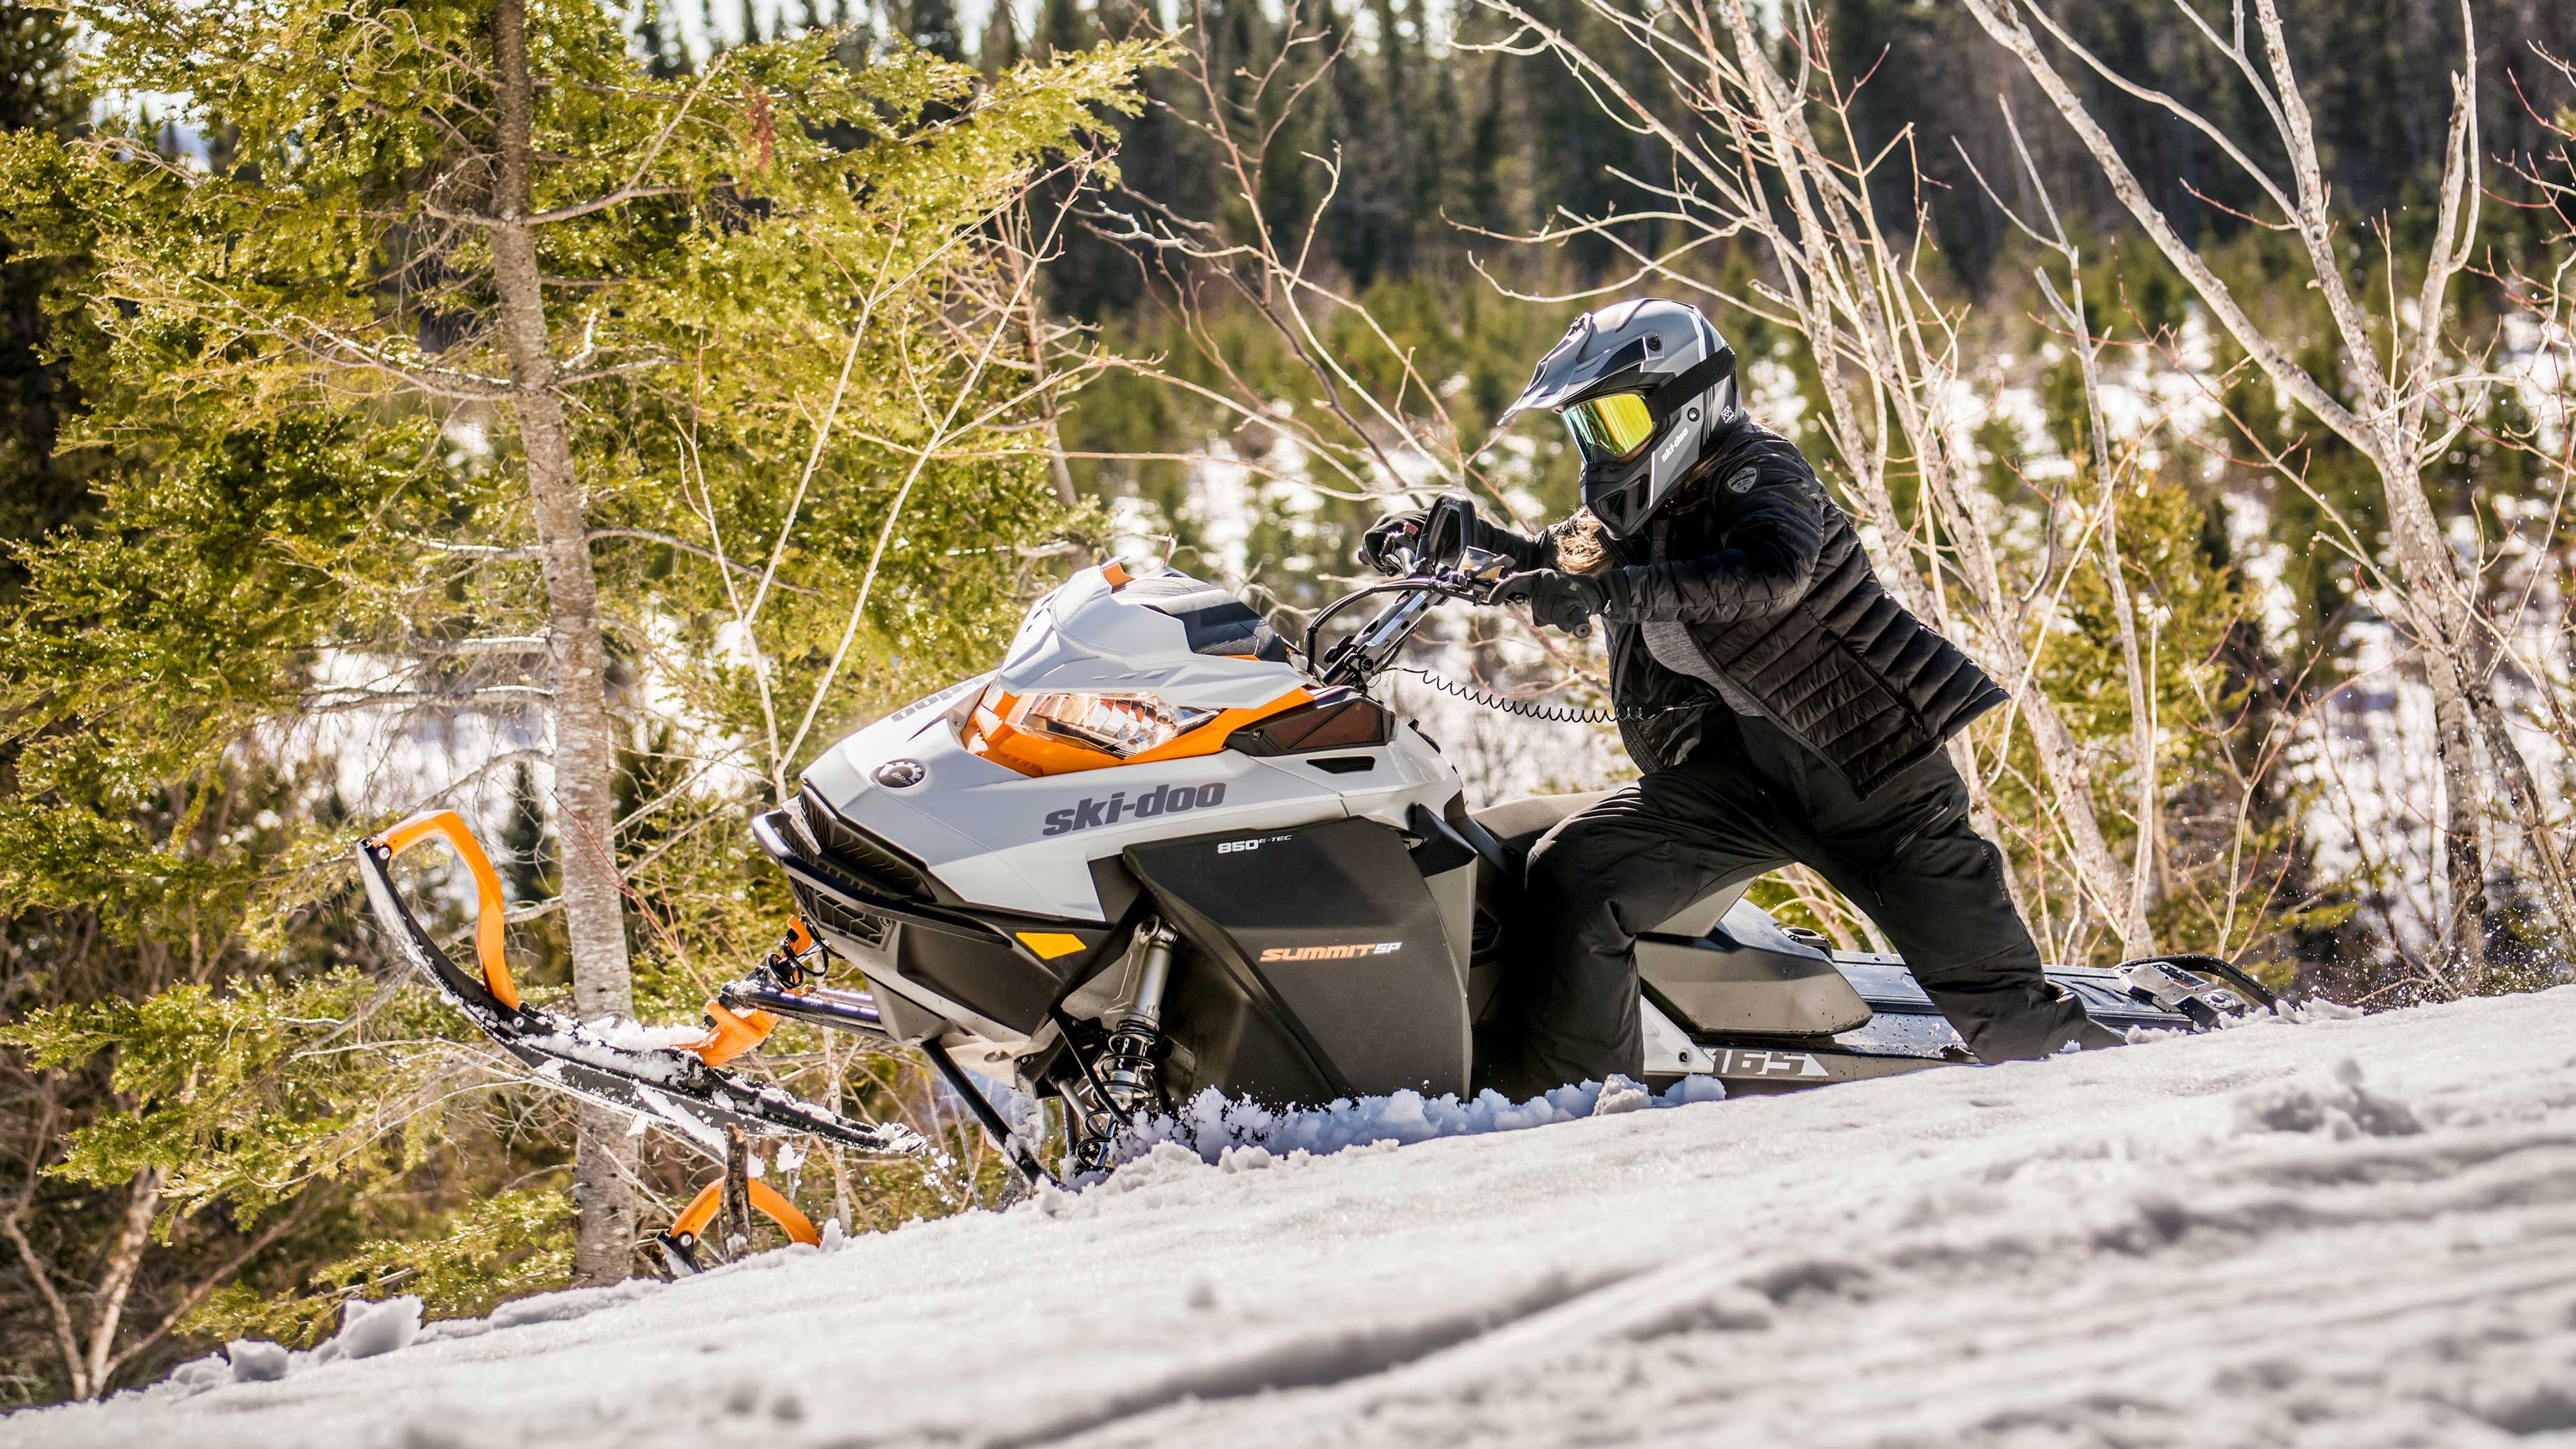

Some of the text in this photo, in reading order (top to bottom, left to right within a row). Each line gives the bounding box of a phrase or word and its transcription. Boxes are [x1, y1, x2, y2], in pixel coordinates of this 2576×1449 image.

[891, 772, 911, 785] BRP
[1043, 782, 1227, 836] ski-doo
[1259, 942, 1402, 962] SUMMIT SP
